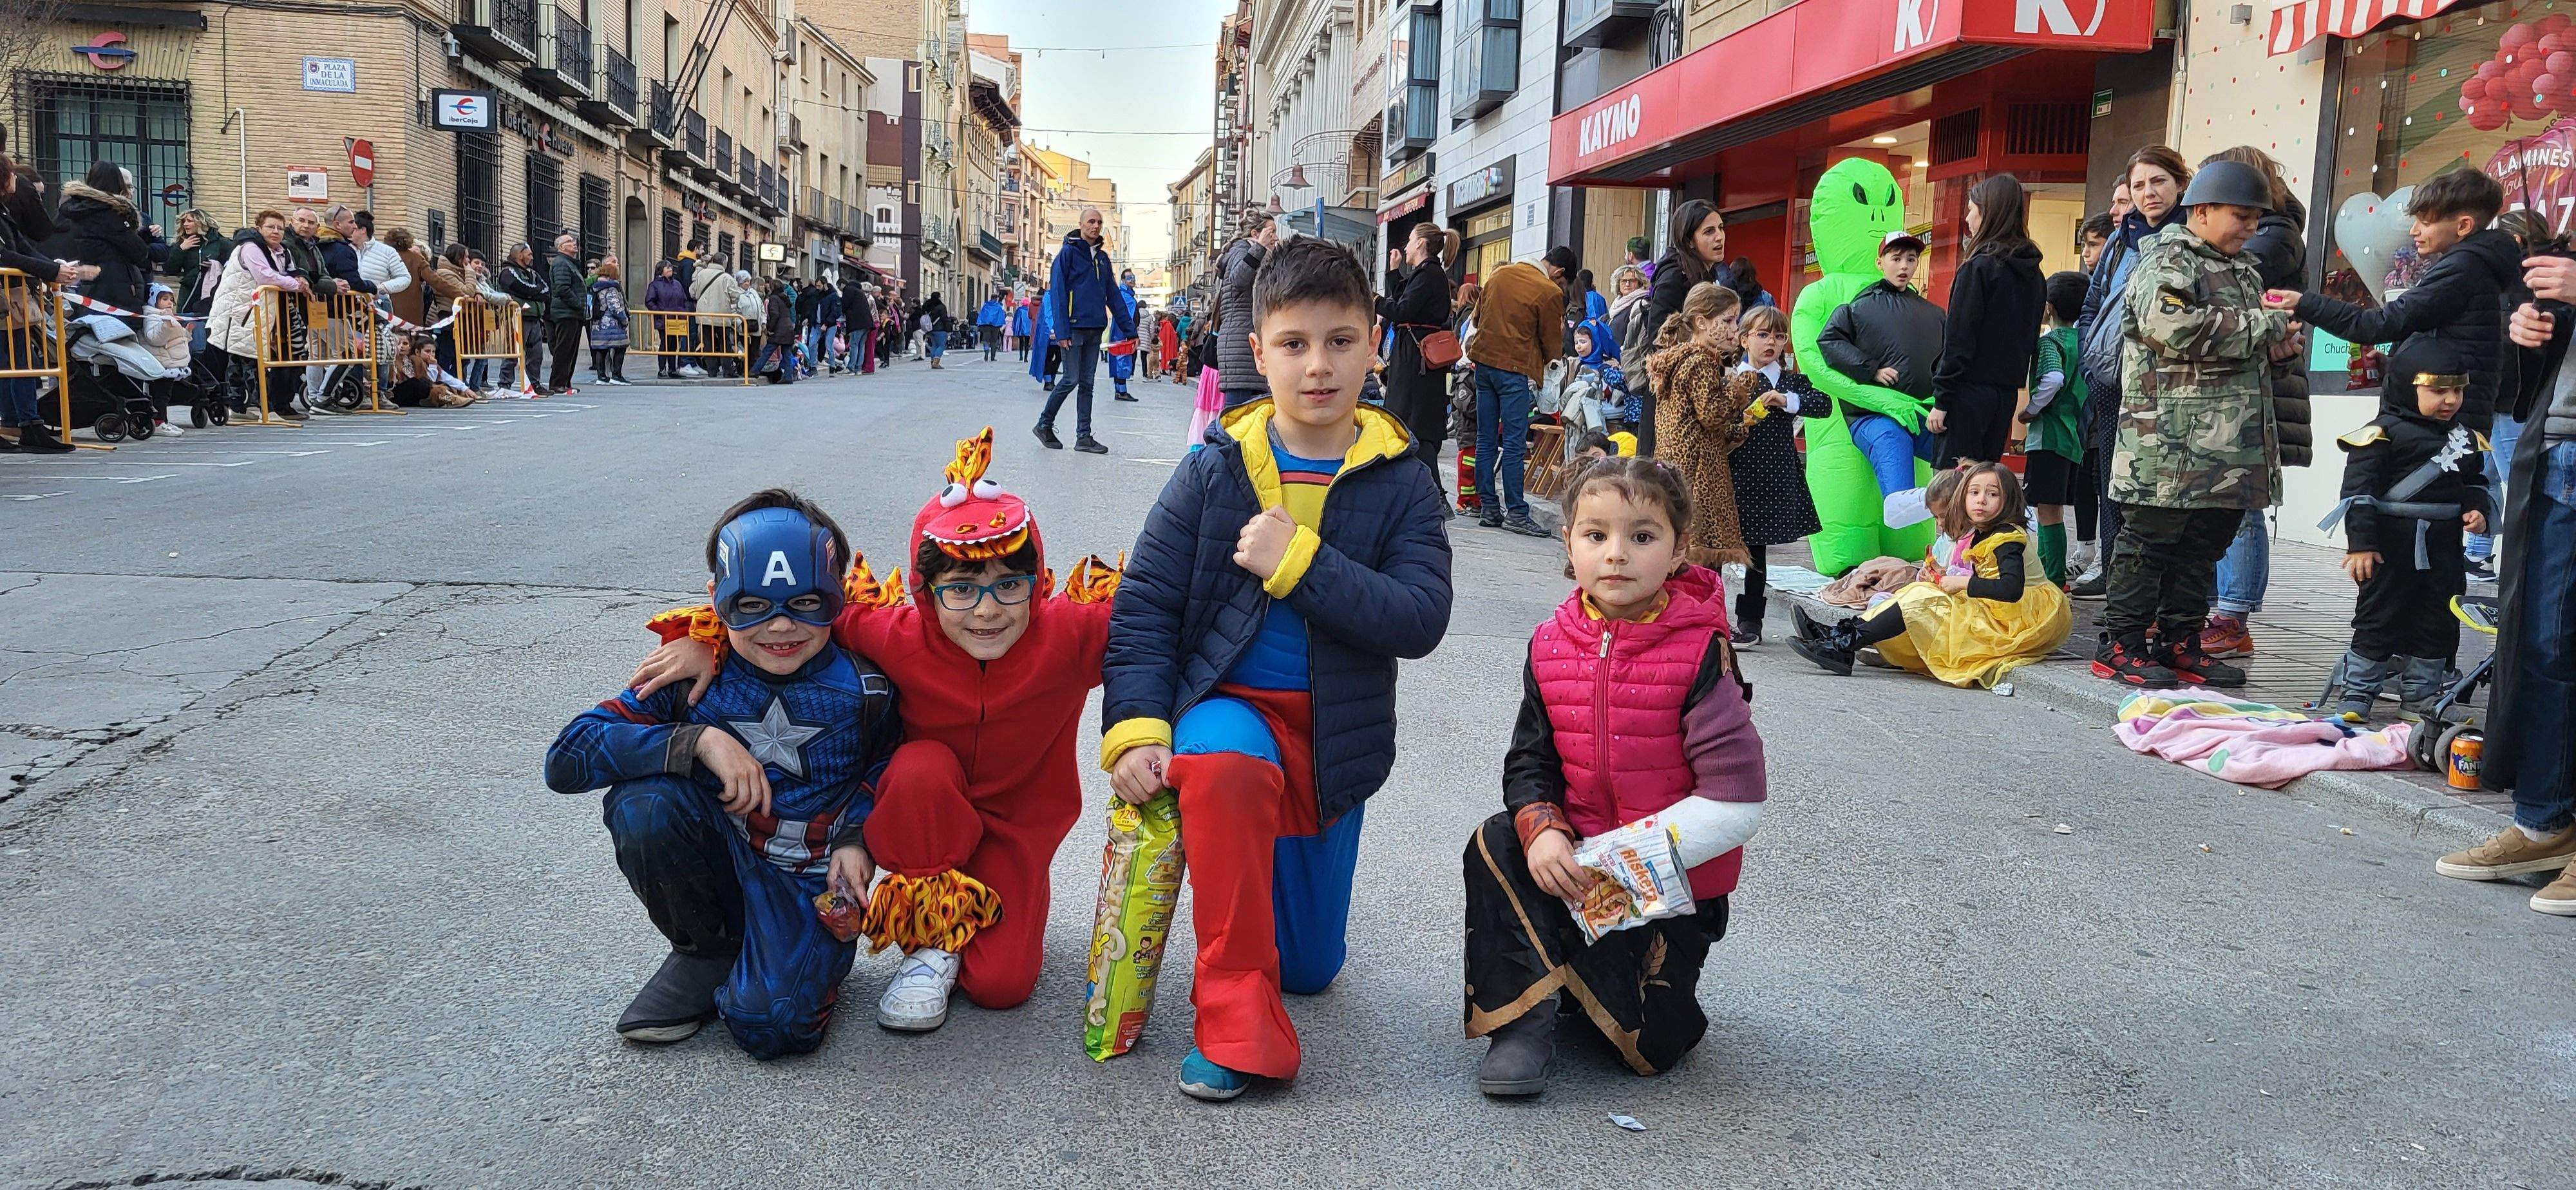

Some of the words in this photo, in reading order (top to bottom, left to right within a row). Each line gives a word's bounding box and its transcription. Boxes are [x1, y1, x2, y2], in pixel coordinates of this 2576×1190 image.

[324, 63, 346, 71] PLAZA
[334, 71, 345, 79] LA
[309, 78, 348, 88] INMACULADA
[1578, 93, 1640, 158] KAYMO
[1805, 252, 1817, 265] REM
[2324, 343, 2351, 354] Chuch
[761, 551, 797, 587] A
[2458, 760, 2482, 771] FANT
